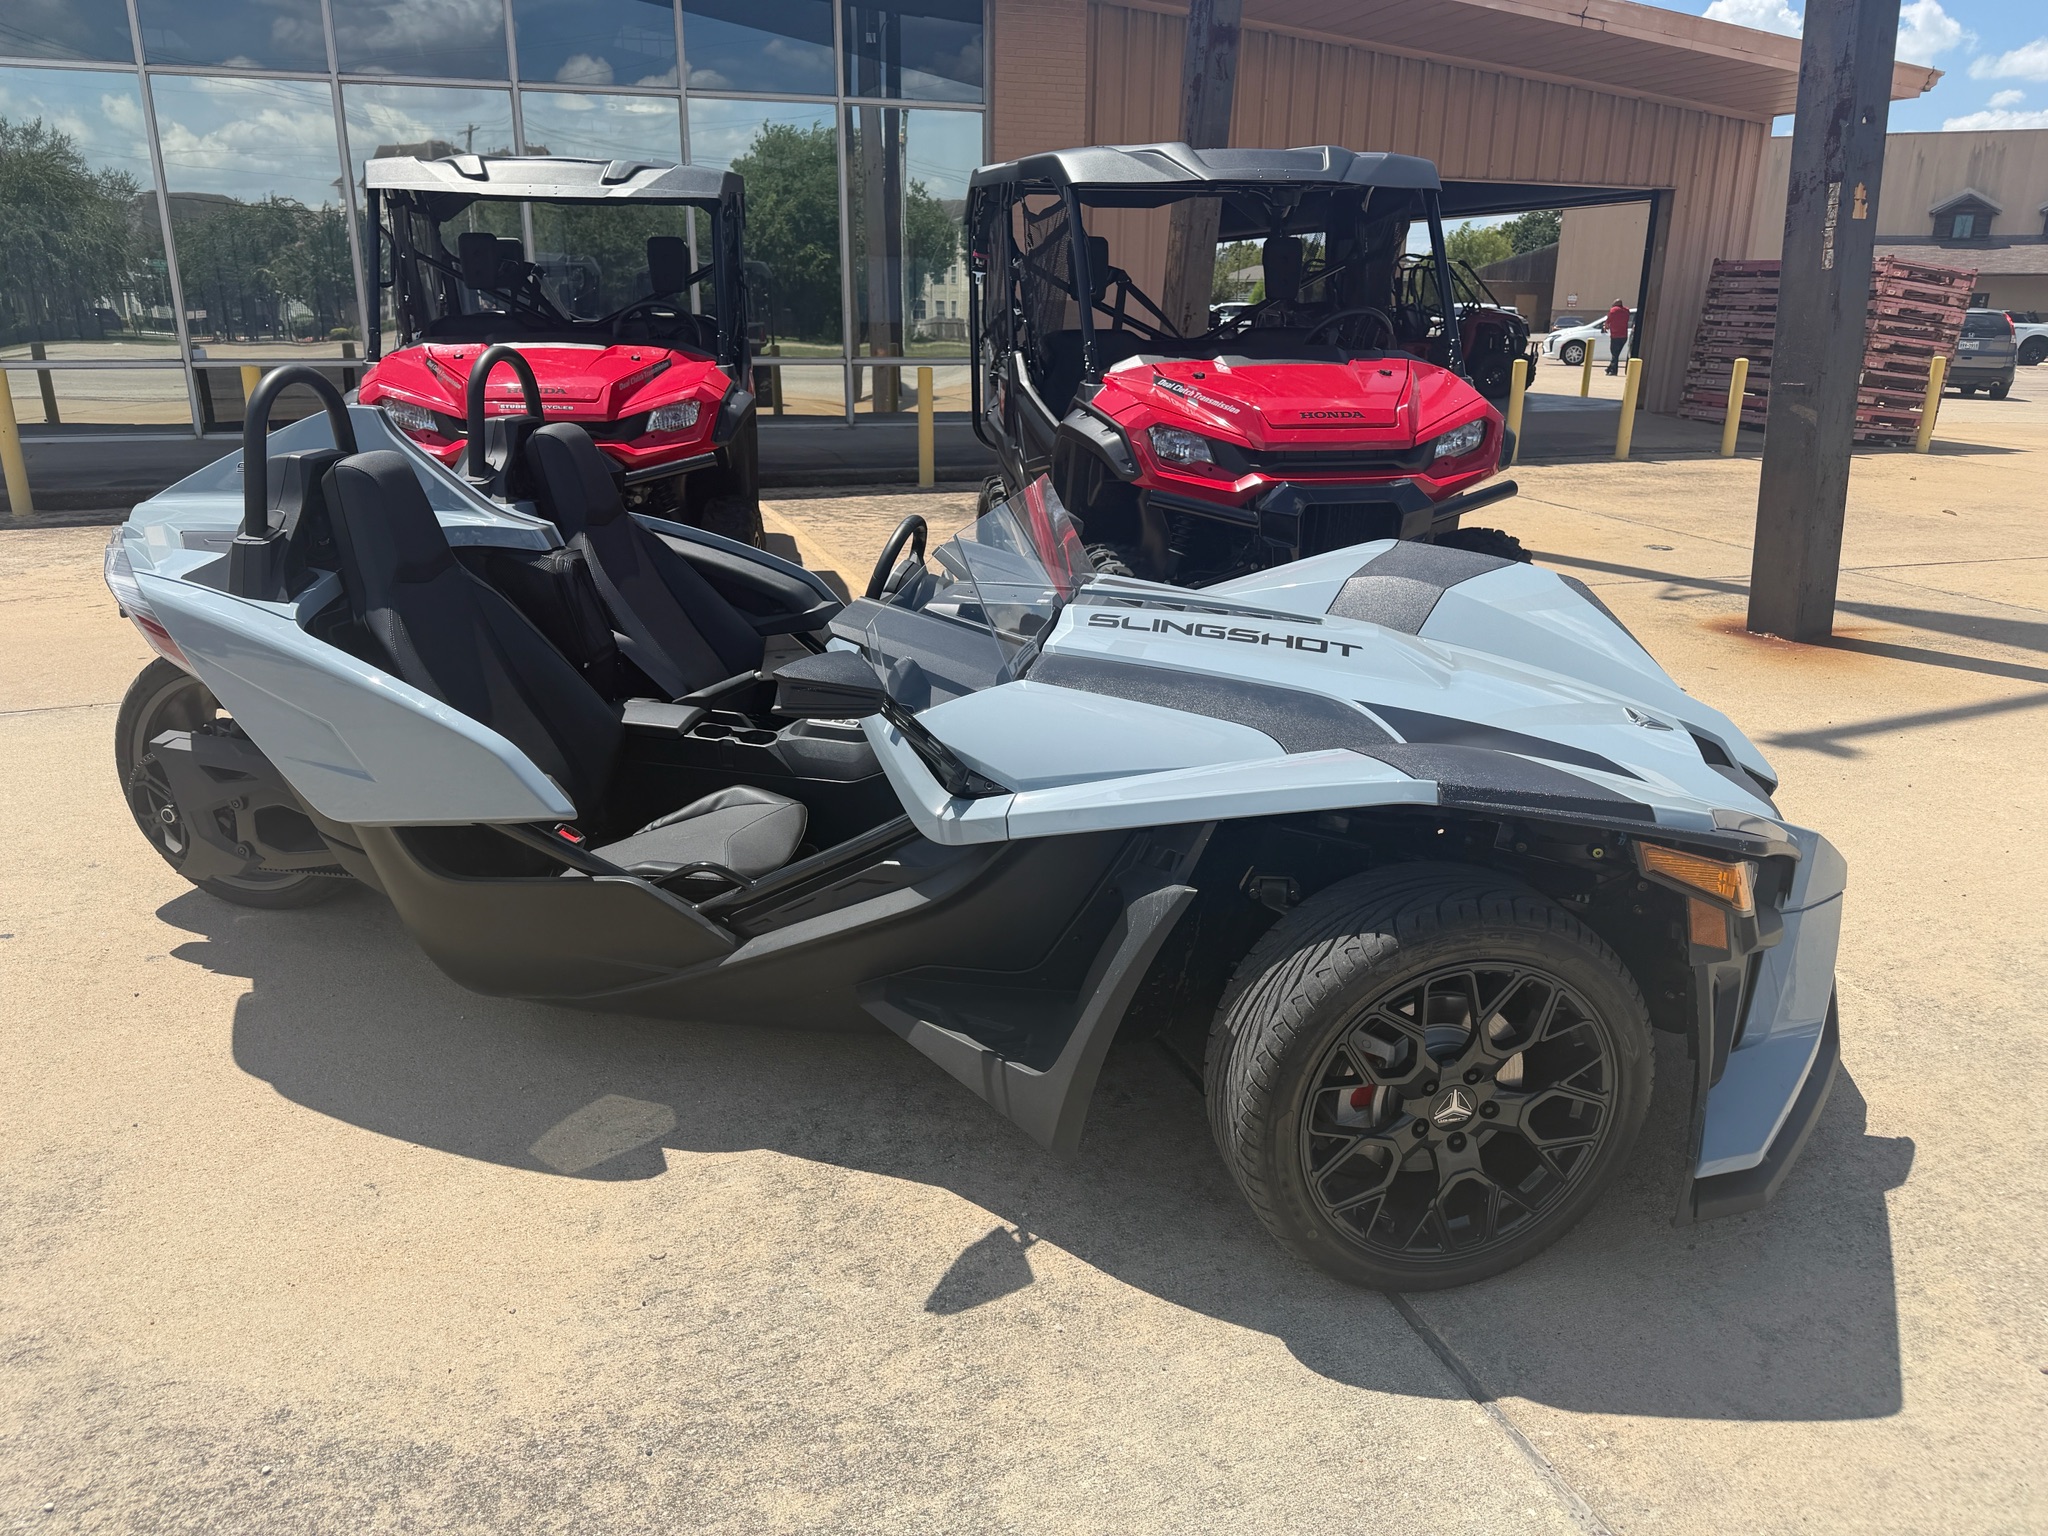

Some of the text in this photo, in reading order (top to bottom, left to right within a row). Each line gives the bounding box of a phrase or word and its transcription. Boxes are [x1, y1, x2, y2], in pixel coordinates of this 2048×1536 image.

[1157, 379, 1241, 415] Dual Clutch Transmission
[1299, 411, 1366, 419] HONDA
[1087, 613, 1364, 657] SLINGSHOT
